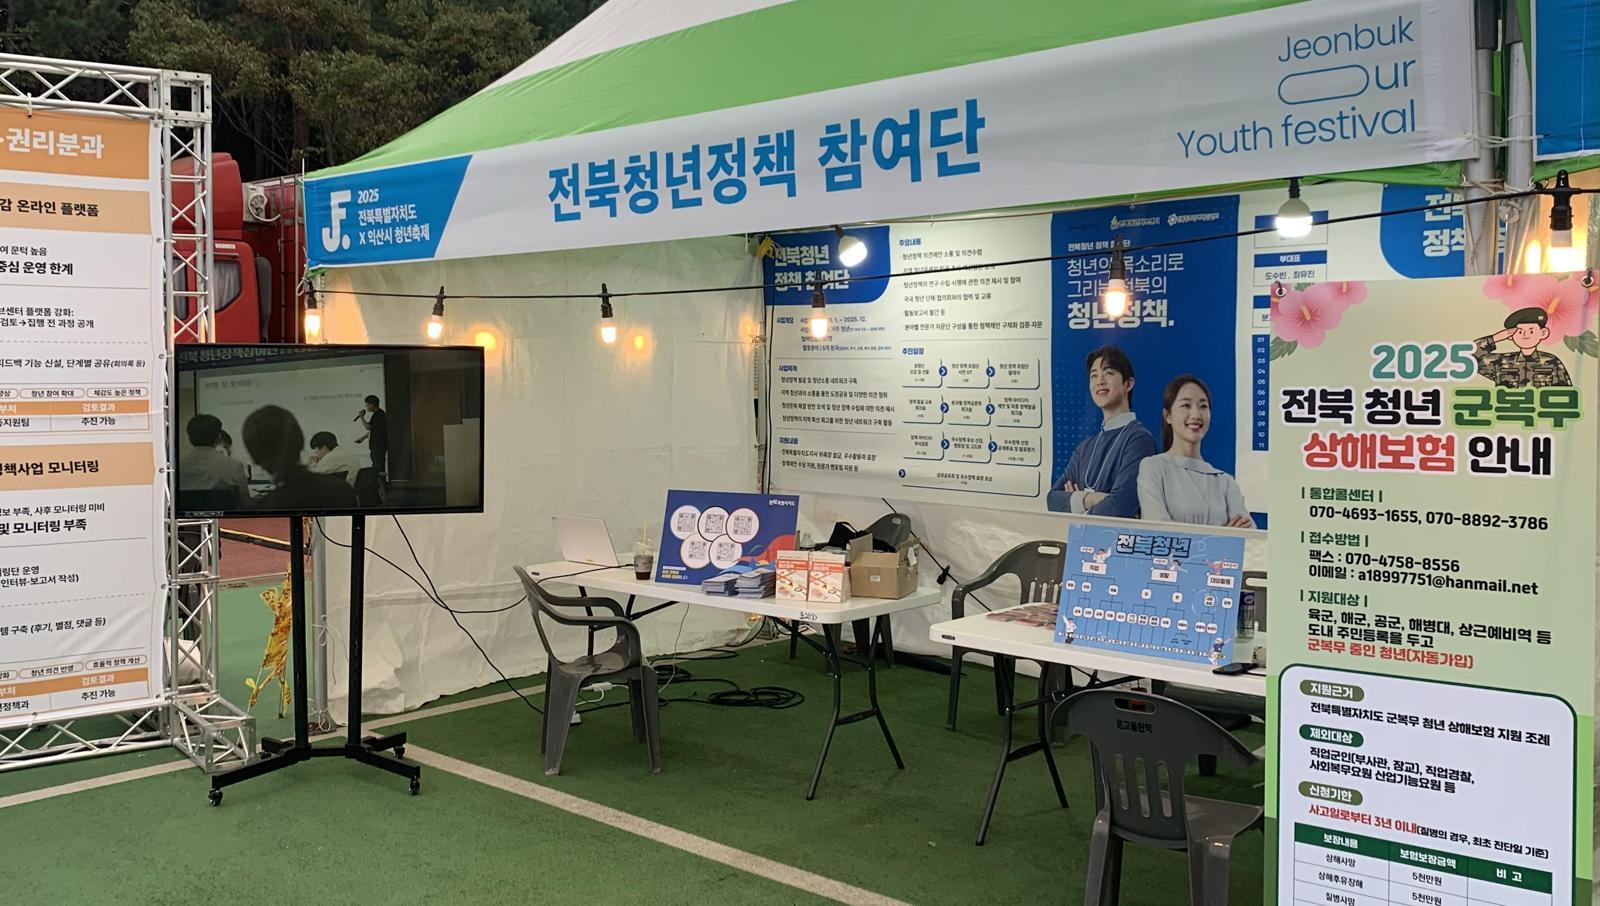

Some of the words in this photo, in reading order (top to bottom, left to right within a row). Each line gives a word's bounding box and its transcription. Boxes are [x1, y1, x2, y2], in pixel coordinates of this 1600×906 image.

[1278, 16, 1414, 62] Jeonbuk
[1177, 120, 1273, 158] Youth
[1281, 98, 1416, 147] festival
[547, 129, 797, 222] 전북청년정책
[818, 98, 986, 193] 참여단
[357, 189, 379, 204] 2025
[17, 200, 56, 214] 온라인
[60, 202, 99, 217] 플랫폼
[358, 203, 417, 225] 전북특별자치도
[359, 231, 366, 245] X
[368, 227, 393, 246] 익산시
[394, 223, 430, 244] 청년축제
[11, 246, 28, 256] 문턱
[30, 247, 47, 256] 높음
[23, 262, 46, 274] 운영
[50, 263, 73, 275] 한계
[26, 308, 51, 316] 플랫폼
[47, 319, 55, 327] 전
[58, 319, 74, 327] 과정
[77, 320, 94, 328] 공개
[25, 359, 41, 368] 기능
[44, 359, 64, 368] 신설,
[67, 359, 91, 368] 단계별
[1373, 344, 1475, 379] 2025
[1282, 389, 1354, 424] 전북
[1365, 389, 1441, 425] 청년
[1453, 389, 1580, 427] 군복무
[81, 417, 98, 425] 추진
[100, 417, 116, 425] 가능
[1304, 433, 1455, 472] 상해보험
[1469, 436, 1551, 475] 안내
[48, 460, 99, 474] 모니터링
[1310, 488, 1374, 502] 통합콜센터
[35, 505, 51, 515] 사후
[54, 504, 86, 514] 모니터링
[88, 503, 105, 512] 미비
[1310, 506, 1422, 525] 070-4693-1655,
[1426, 512, 1548, 530] 070-8892-3786
[12, 520, 60, 534] 모니터링
[63, 518, 87, 531] 부족
[1116, 534, 1191, 558] 전북청년
[1309, 532, 1360, 546] 접수방법
[22, 565, 40, 575] 운영
[1309, 549, 1334, 563] 팩스
[1345, 553, 1460, 572] 070-4758-8556
[58, 574, 79, 583] 작성)
[1309, 565, 1347, 579] 이메일
[1358, 570, 1538, 595] a18997751@hanmail.net
[1308, 591, 1360, 607] 지원대상
[11, 626, 28, 635] 구축
[76, 619, 93, 628] 댓글
[94, 617, 106, 626] 등)
[1308, 609, 1337, 623] 육군,
[1341, 611, 1370, 627] 해군,
[1375, 615, 1404, 630] 공군,
[1409, 619, 1454, 635] 해병대,
[1459, 623, 1532, 643] 상근예비역
[1536, 630, 1552, 645] 등
[1308, 624, 1333, 638] 도내
[1337, 627, 1402, 644] 주민등록을
[1407, 634, 1434, 648] 두고
[1308, 639, 1346, 653] 군복무
[1350, 642, 1376, 658] 중인
[1380, 646, 1473, 669] 청년(자동가입)
[81, 691, 98, 700] 추진
[100, 688, 116, 698] 가능
[1310, 683, 1353, 698] 지원근거
[1310, 702, 1384, 722] 전북특별자치도
[1387, 711, 1419, 727] 군복무
[1422, 717, 1445, 731] 청년
[1448, 720, 1495, 739] 상해보험
[1498, 727, 1522, 742] 지원
[1525, 731, 1551, 747] 조례
[1310, 727, 1353, 744] 제외대상
[1309, 760, 1372, 779] 사회복무요원
[1375, 768, 1441, 791] 산업기능요원
[1444, 781, 1456, 794] 등
[1310, 747, 1391, 770] 직업군인(부사관,
[1393, 759, 1423, 777] 장교),
[1425, 765, 1475, 785] 직업경찰,
[1309, 785, 1352, 801] 신청기한
[1309, 804, 1371, 825] 사고일로부터
[1375, 816, 1392, 829] 3년
[1450, 831, 1471, 845] 경우,
[1473, 836, 1492, 849] 최초
[1494, 840, 1522, 854] 진단일
[1525, 845, 1549, 860] 기준)
[1323, 833, 1358, 849] 보장내용
[1400, 849, 1457, 869] 보험보장금액
[1325, 853, 1356, 868] 상해사망
[1412, 872, 1442, 886] 5천만원
[1318, 871, 1363, 889] 상해후유장해
[1412, 892, 1442, 906] 5천만원
